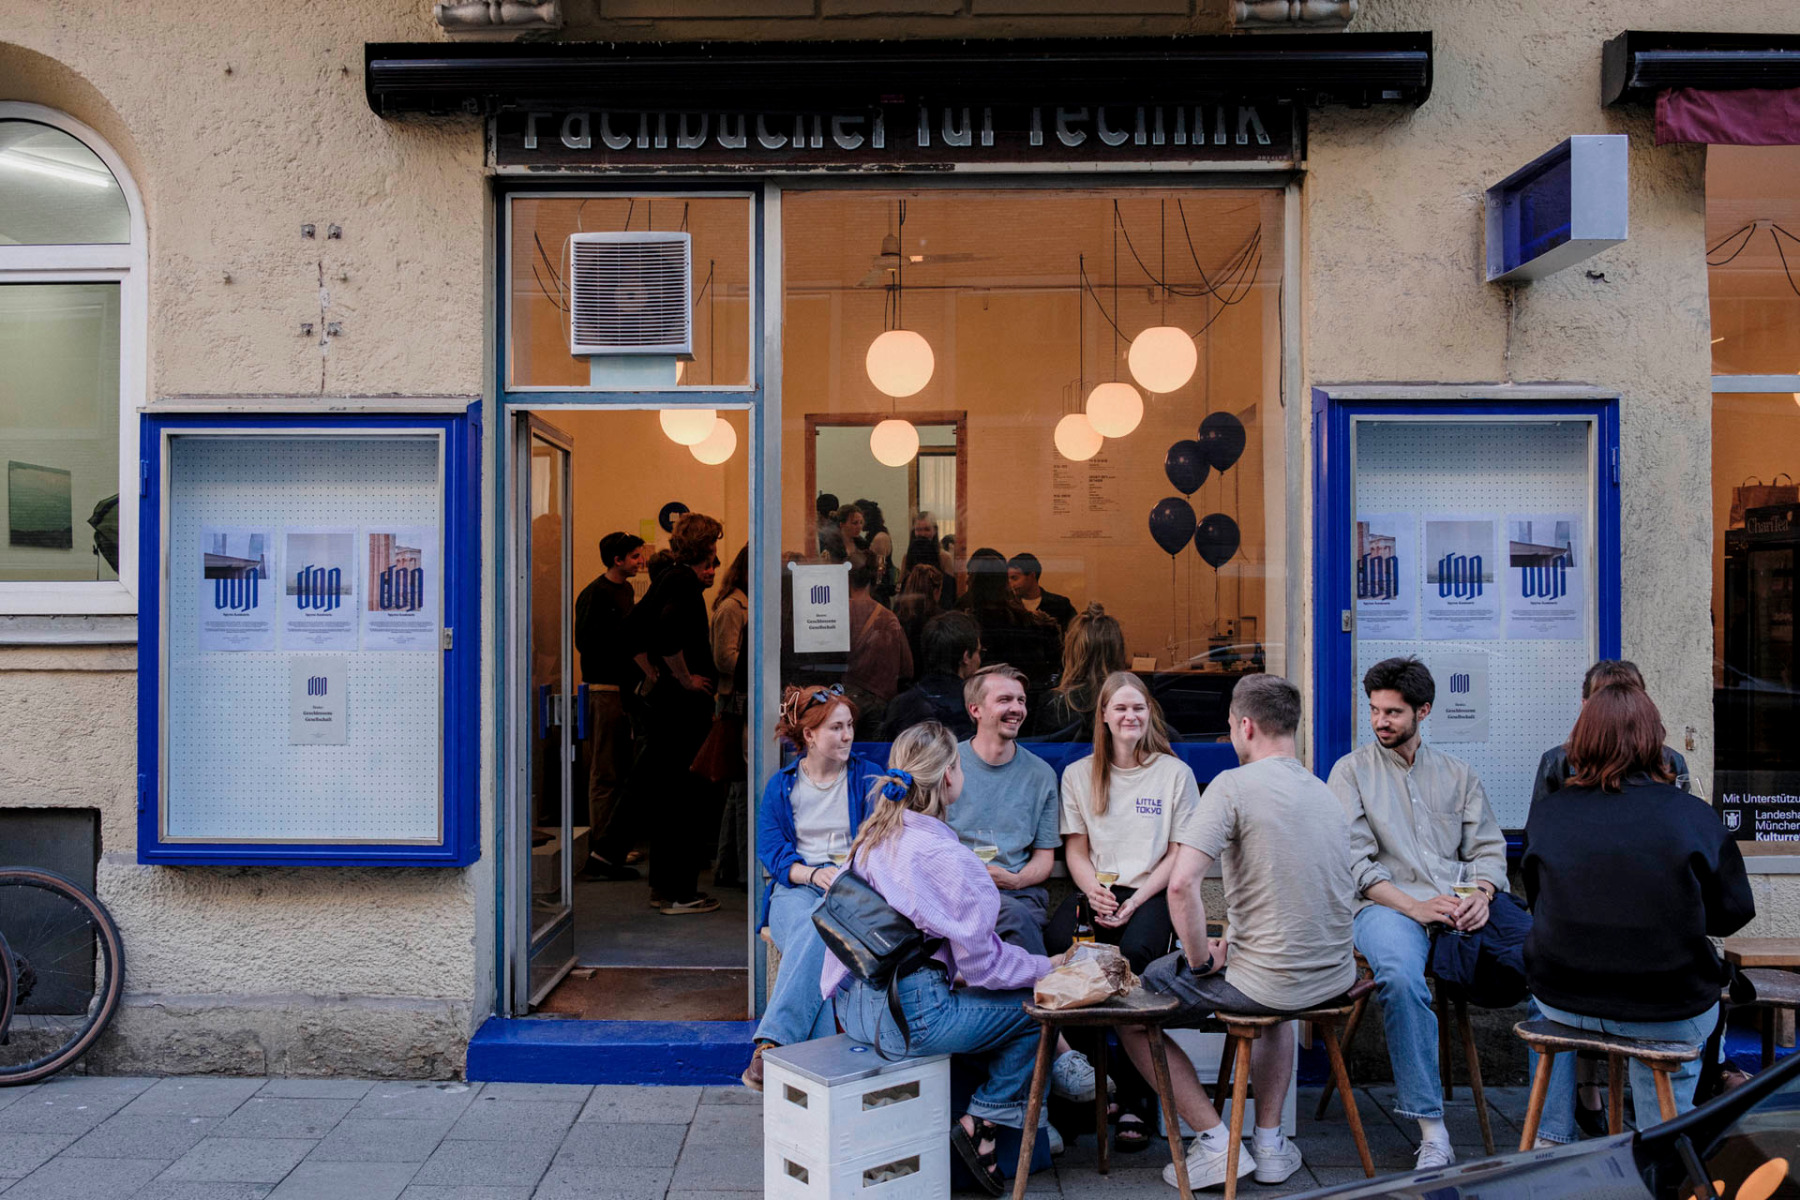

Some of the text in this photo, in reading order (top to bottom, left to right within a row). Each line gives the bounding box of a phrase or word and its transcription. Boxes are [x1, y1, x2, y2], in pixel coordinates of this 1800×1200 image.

[1747, 515, 1789, 534] ChariTea
[1136, 798, 1162, 806] LITTLE
[1722, 793, 1800, 803] Mit Unterstützu
[1136, 806, 1162, 815] TOKYO
[1755, 831, 1800, 842] Kulturre
